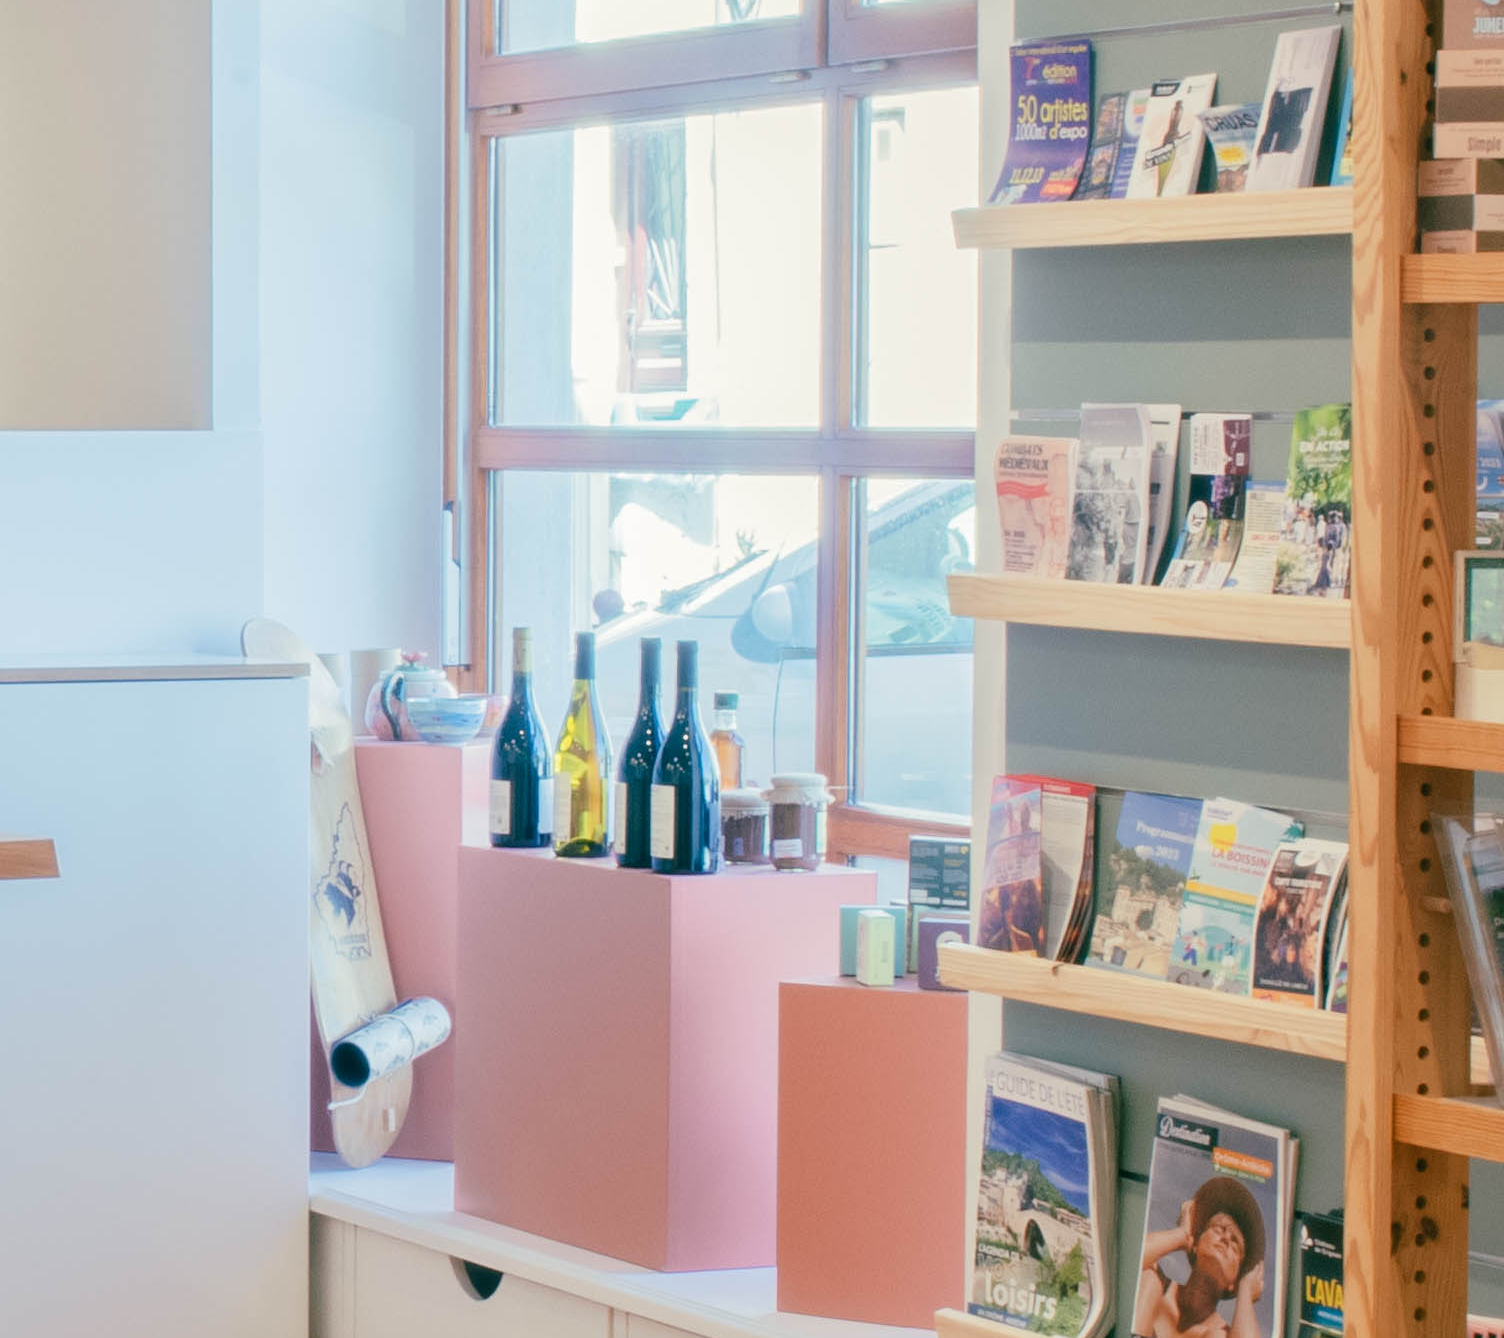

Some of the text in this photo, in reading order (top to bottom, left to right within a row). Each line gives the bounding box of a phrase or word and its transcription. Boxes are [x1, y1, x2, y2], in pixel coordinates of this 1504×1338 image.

[1018, 95, 1088, 126] 50 artistes
[1049, 123, 1088, 141] d'expo
[1467, 136, 1502, 154] Simple
[1227, 851, 1269, 869] BOISSIN
[995, 1071, 1033, 1101] GUIDE
[1037, 1083, 1053, 1106] DE
